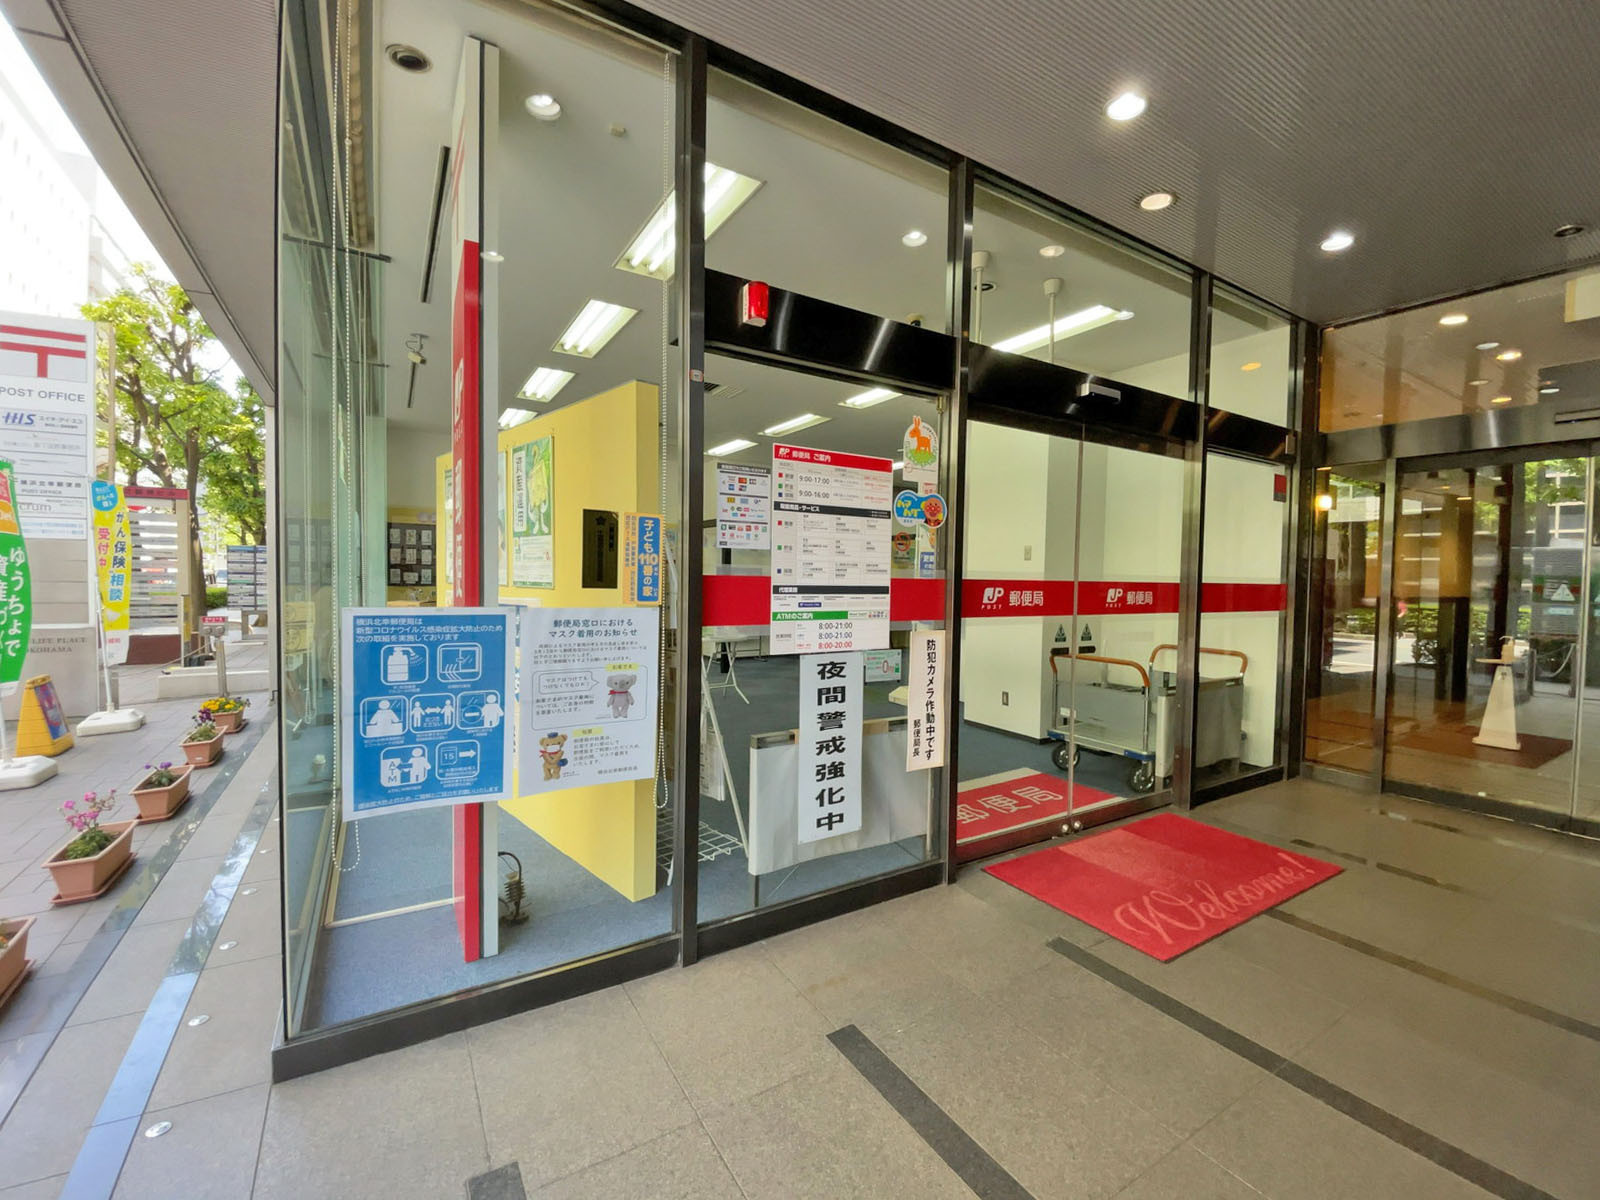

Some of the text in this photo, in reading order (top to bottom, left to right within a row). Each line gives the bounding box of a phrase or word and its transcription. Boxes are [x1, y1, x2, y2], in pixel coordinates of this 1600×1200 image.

[38, 390, 86, 402] OFFICE
[799, 475, 830, 485] 9:00-17:00
[799, 490, 830, 499] 9:00-16:00
[97, 527, 111, 567] 受付中
[5, 547, 25, 657] ゆうちょで
[1009, 590, 1044, 607] 郵便局
[1127, 591, 1153, 605] 郵便局
[776, 612, 813, 620] ATMのご案内
[553, 619, 633, 628] 郵便局窓口における
[818, 622, 853, 630] 8:00-21:00
[549, 629, 637, 638] マスク着用のお知らせ
[818, 631, 853, 640] 8:00-21:00
[818, 641, 853, 650] 8:00-20:00
[925, 639, 936, 760] 防犯カメラ作動中です
[912, 719, 921, 757] 郵便局長
[815, 661, 847, 830] 夜間警戒強化中
[388, 761, 398, 783] ATM
[1114, 852, 1315, 945] Welcome!
